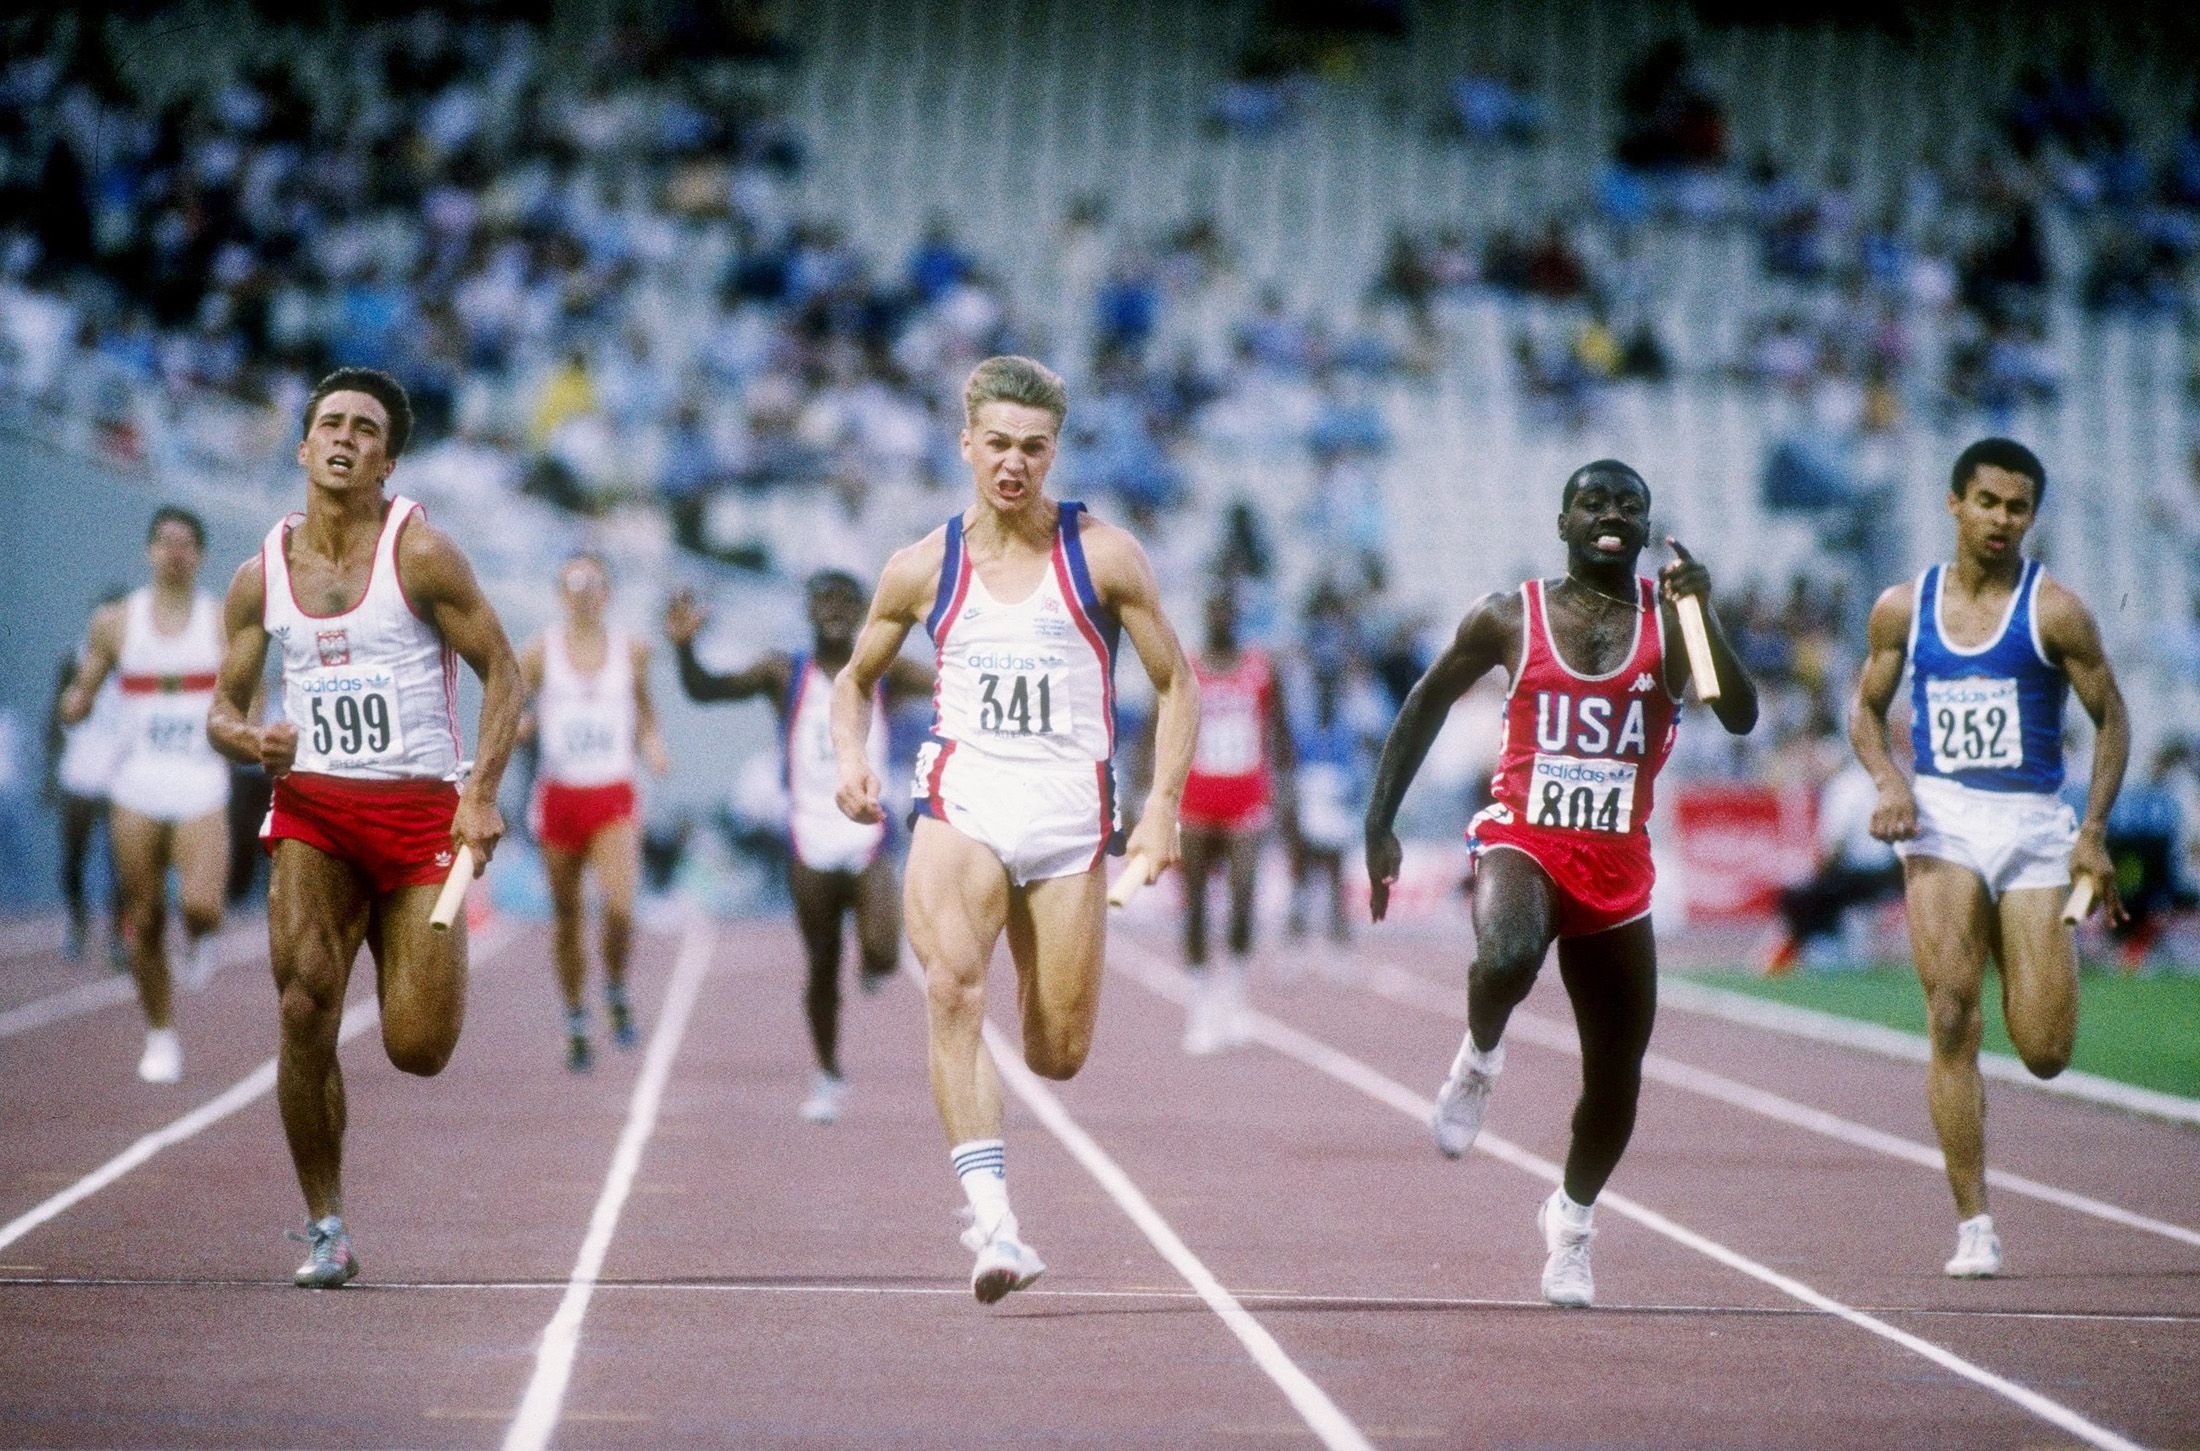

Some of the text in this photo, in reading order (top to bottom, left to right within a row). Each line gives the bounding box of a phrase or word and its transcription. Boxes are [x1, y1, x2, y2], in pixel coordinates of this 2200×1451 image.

[303, 676, 362, 692] adidas
[968, 653, 1035, 670] adidas
[312, 693, 390, 755] 599
[979, 673, 1053, 735] 341
[1537, 692, 1646, 754] USA
[1938, 707, 2007, 760] 252
[1537, 763, 1605, 783] adidas
[1537, 780, 1621, 832] 804
